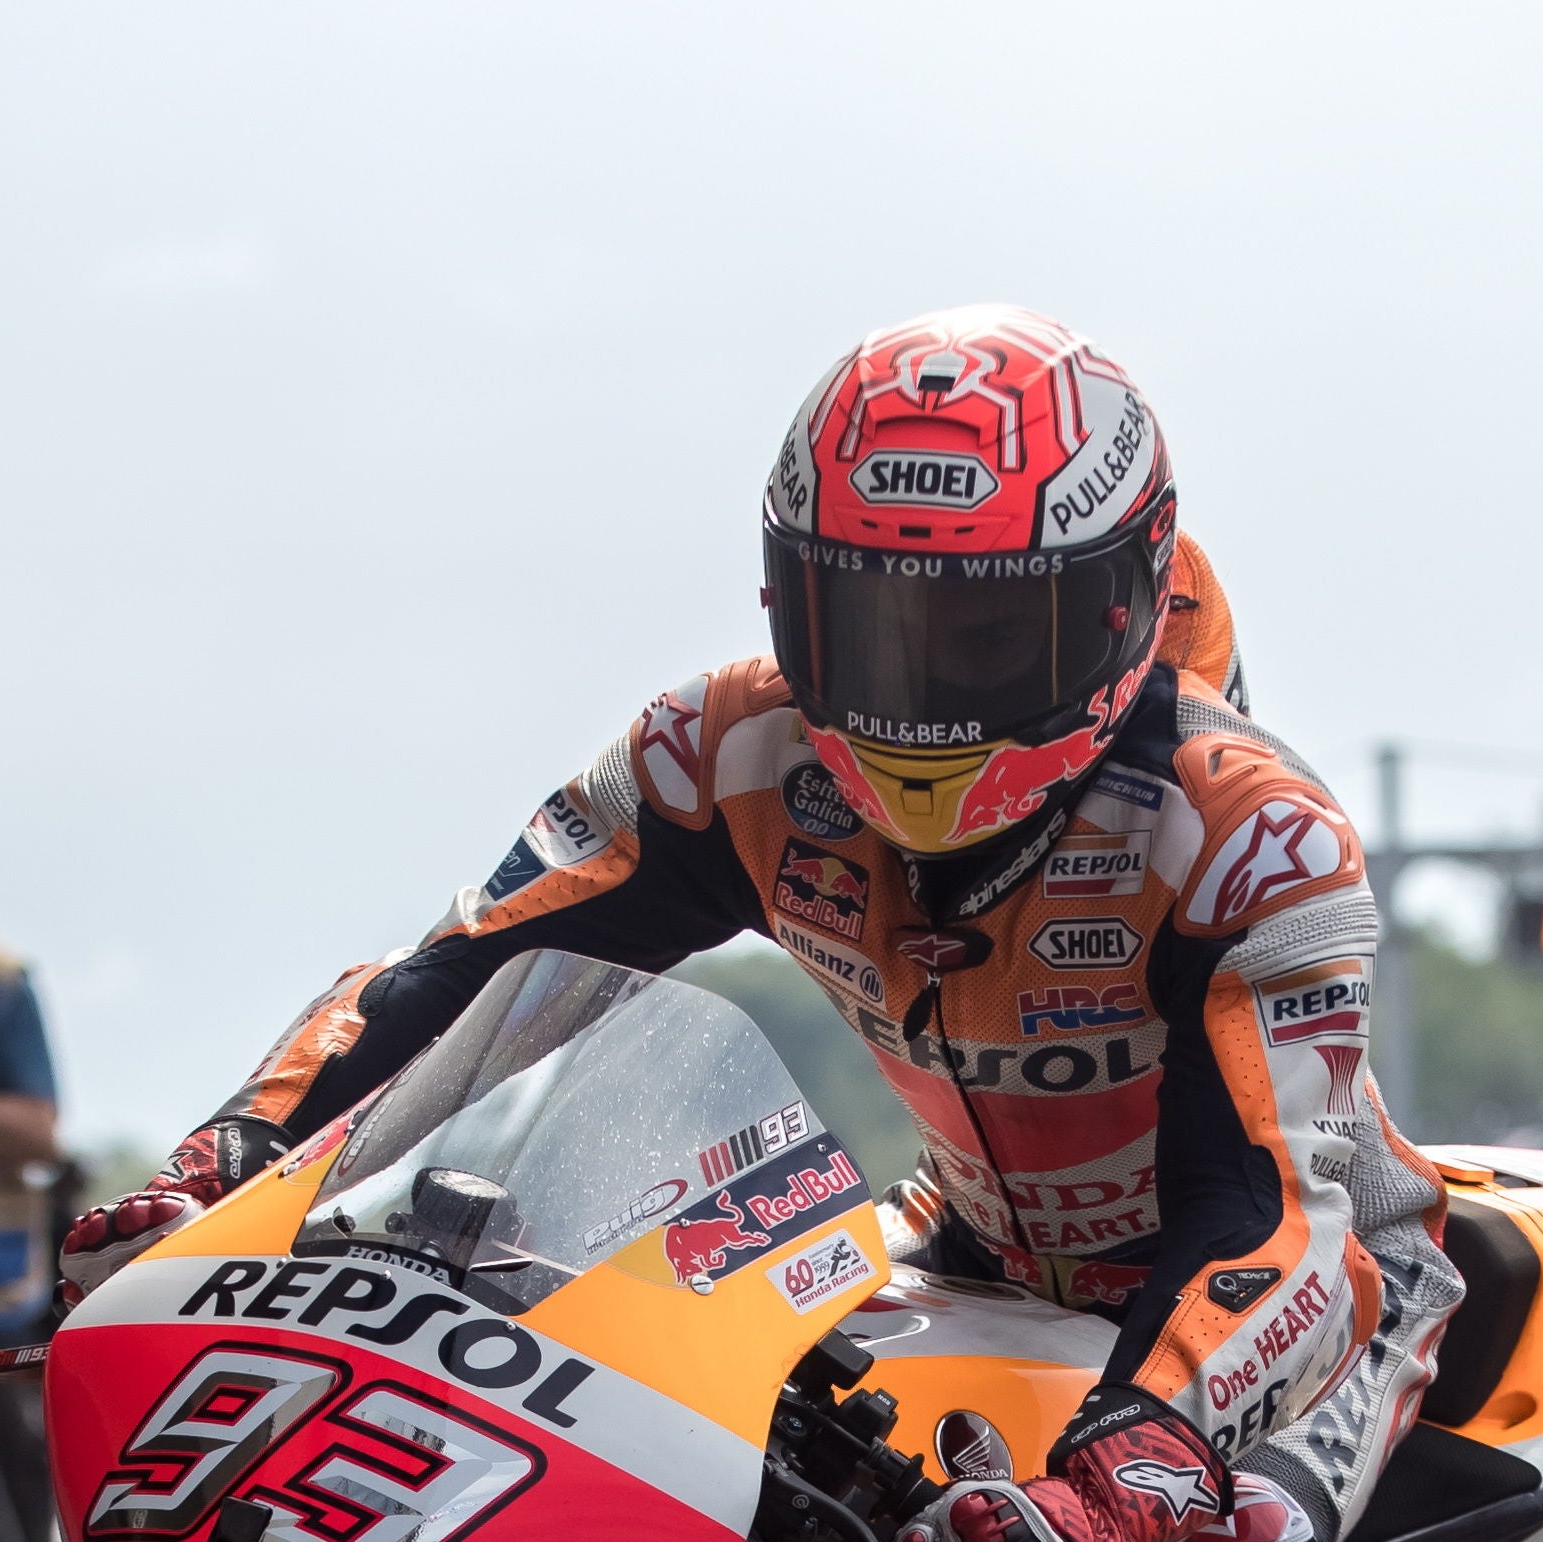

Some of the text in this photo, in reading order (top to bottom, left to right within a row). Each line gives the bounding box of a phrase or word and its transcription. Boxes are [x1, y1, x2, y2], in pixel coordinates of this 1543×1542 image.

[869, 460, 977, 499] SHOEI
[1050, 391, 1152, 535] PULL&BEAR
[798, 541, 1064, 579] GIVES YOU WINGS
[847, 710, 983, 744] PULL&BEAR
[794, 789, 854, 829] Galicia
[959, 808, 1066, 916] alpinestars
[1049, 853, 1143, 877] REPSOL
[779, 923, 858, 983] Allianz
[1048, 928, 1126, 960] SHOEI
[1017, 983, 1148, 1036] HRC
[1273, 981, 1370, 1021] REPSOL
[758, 1101, 809, 1155] 93
[746, 1150, 861, 1230] Red Bull
[347, 1245, 452, 1288] HONDA
[785, 1258, 814, 1294] 60
[795, 1263, 870, 1308] Honda Racing
[177, 1259, 596, 1429] REPSOL
[1208, 1270, 1329, 1411] One HEART
